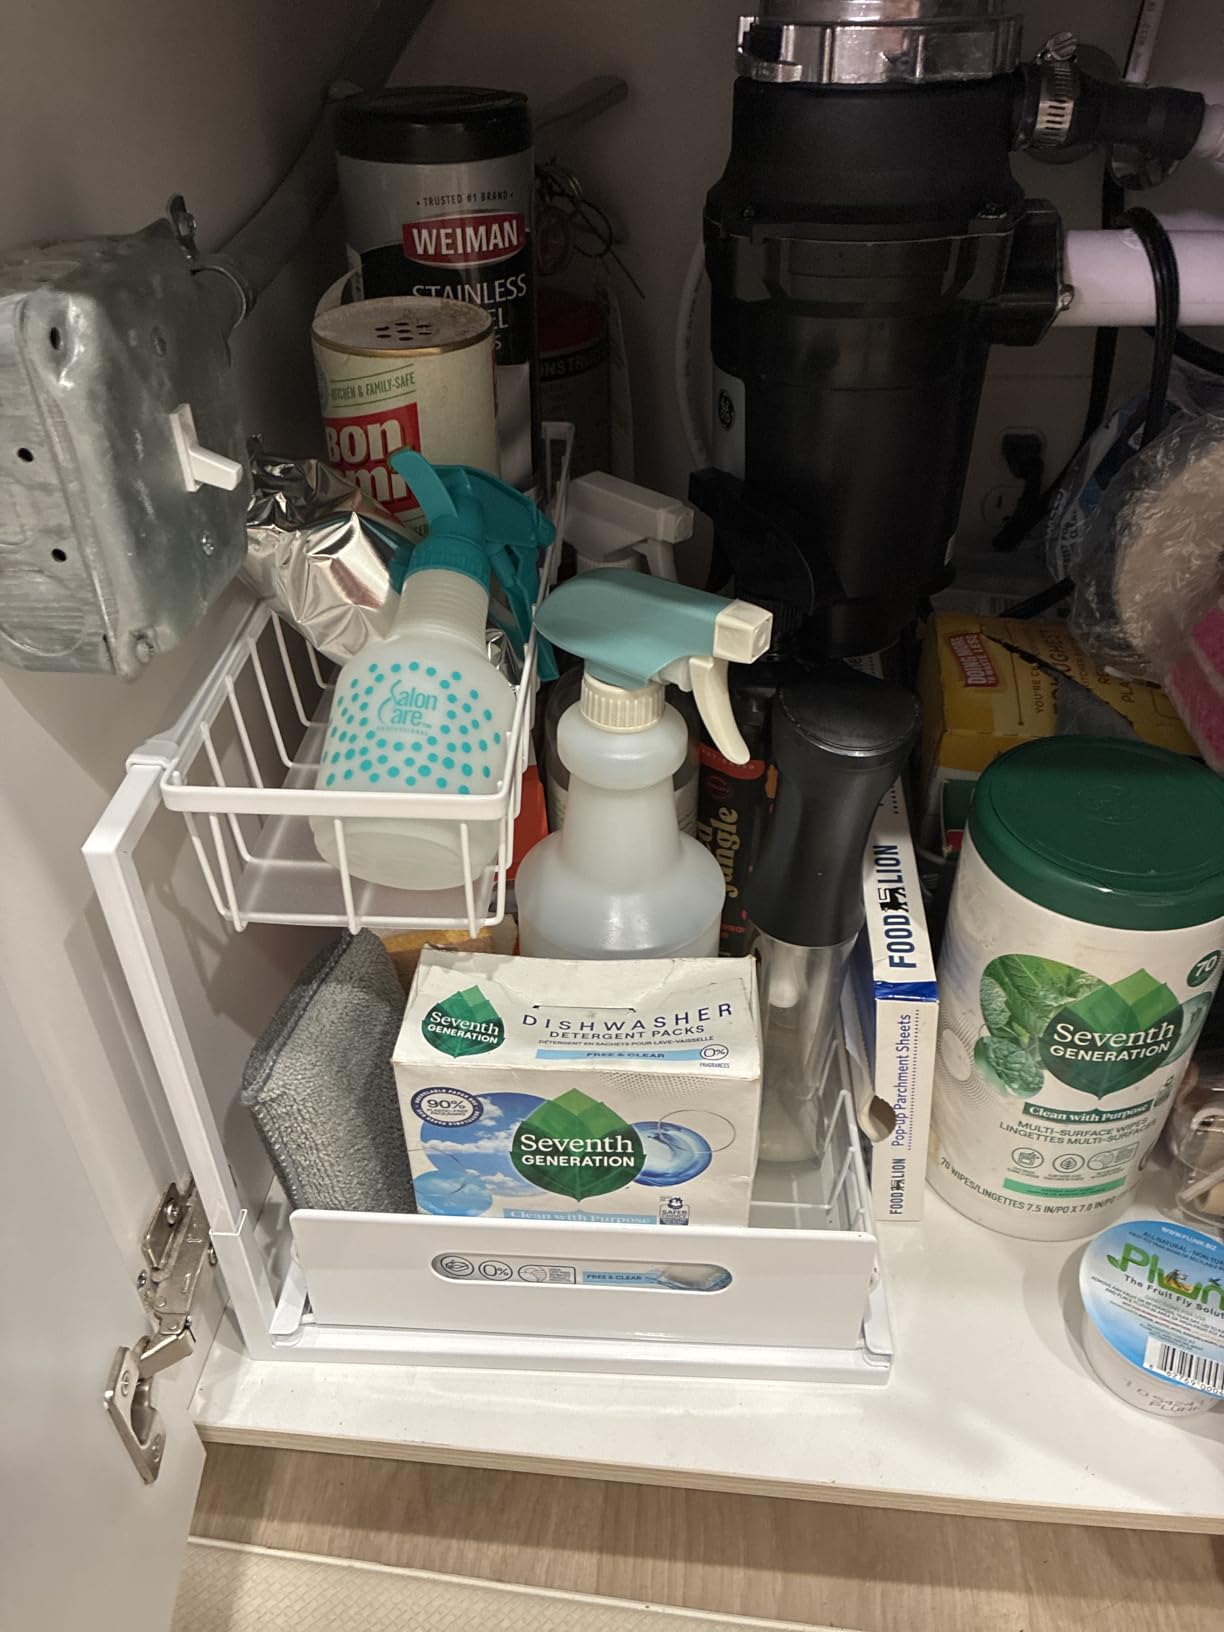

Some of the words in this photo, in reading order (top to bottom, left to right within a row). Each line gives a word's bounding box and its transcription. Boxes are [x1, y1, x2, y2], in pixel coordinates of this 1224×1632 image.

[423, 195, 463, 207] TRUSTED
[480, 190, 508, 201] BRAND
[411, 219, 519, 256] WEIMAN
[411, 273, 528, 305] STAINLESS
[365, 371, 416, 396] FAMILY-SAFE
[324, 418, 402, 464] Bon
[344, 465, 409, 501] mi
[390, 679, 438, 711] Salon
[377, 697, 424, 727] Care
[871, 845, 904, 884] LION
[884, 914, 917, 969] FOOD
[1195, 955, 1218, 977] 70
[430, 1011, 500, 1036] Seventh
[522, 1003, 732, 1031] DISHWASHER
[427, 1024, 498, 1044] GENERATION
[550, 1030, 646, 1041] DETERGENT
[652, 1025, 705, 1038] PACKS
[896, 1014, 911, 1052] Sheets
[1053, 1021, 1175, 1047] Seventh
[703, 1048, 726, 1058] 0%
[1050, 1041, 1170, 1062] GENERATION
[893, 1055, 909, 1110] Parchment
[427, 1099, 466, 1109] 90%
[1029, 1106, 1067, 1121] Clean
[1068, 1110, 1101, 1122] with
[1101, 1103, 1150, 1121] Purpose
[891, 1112, 908, 1147] Pop-up
[999, 1122, 1065, 1144] LINGETTES
[1019, 1121, 1113, 1137] MULTI-SURFACE
[520, 1134, 635, 1153] Seventh
[521, 1154, 636, 1168] GENERATION
[891, 1156, 906, 1180] LION
[940, 1156, 951, 1170] 70
[951, 1166, 1026, 1210] WIPES/LINGETTES
[1070, 1205, 1079, 1213] X
[887, 1187, 904, 1215] FOOD
[510, 1210, 551, 1220] Clean
[553, 1212, 587, 1221] with
[590, 1214, 651, 1224] Purpose
[483, 1264, 510, 1277] 0%
[1122, 1273, 1145, 1288] The
[1146, 1284, 1174, 1299] Fruit
[1175, 1295, 1193, 1308] Fly
